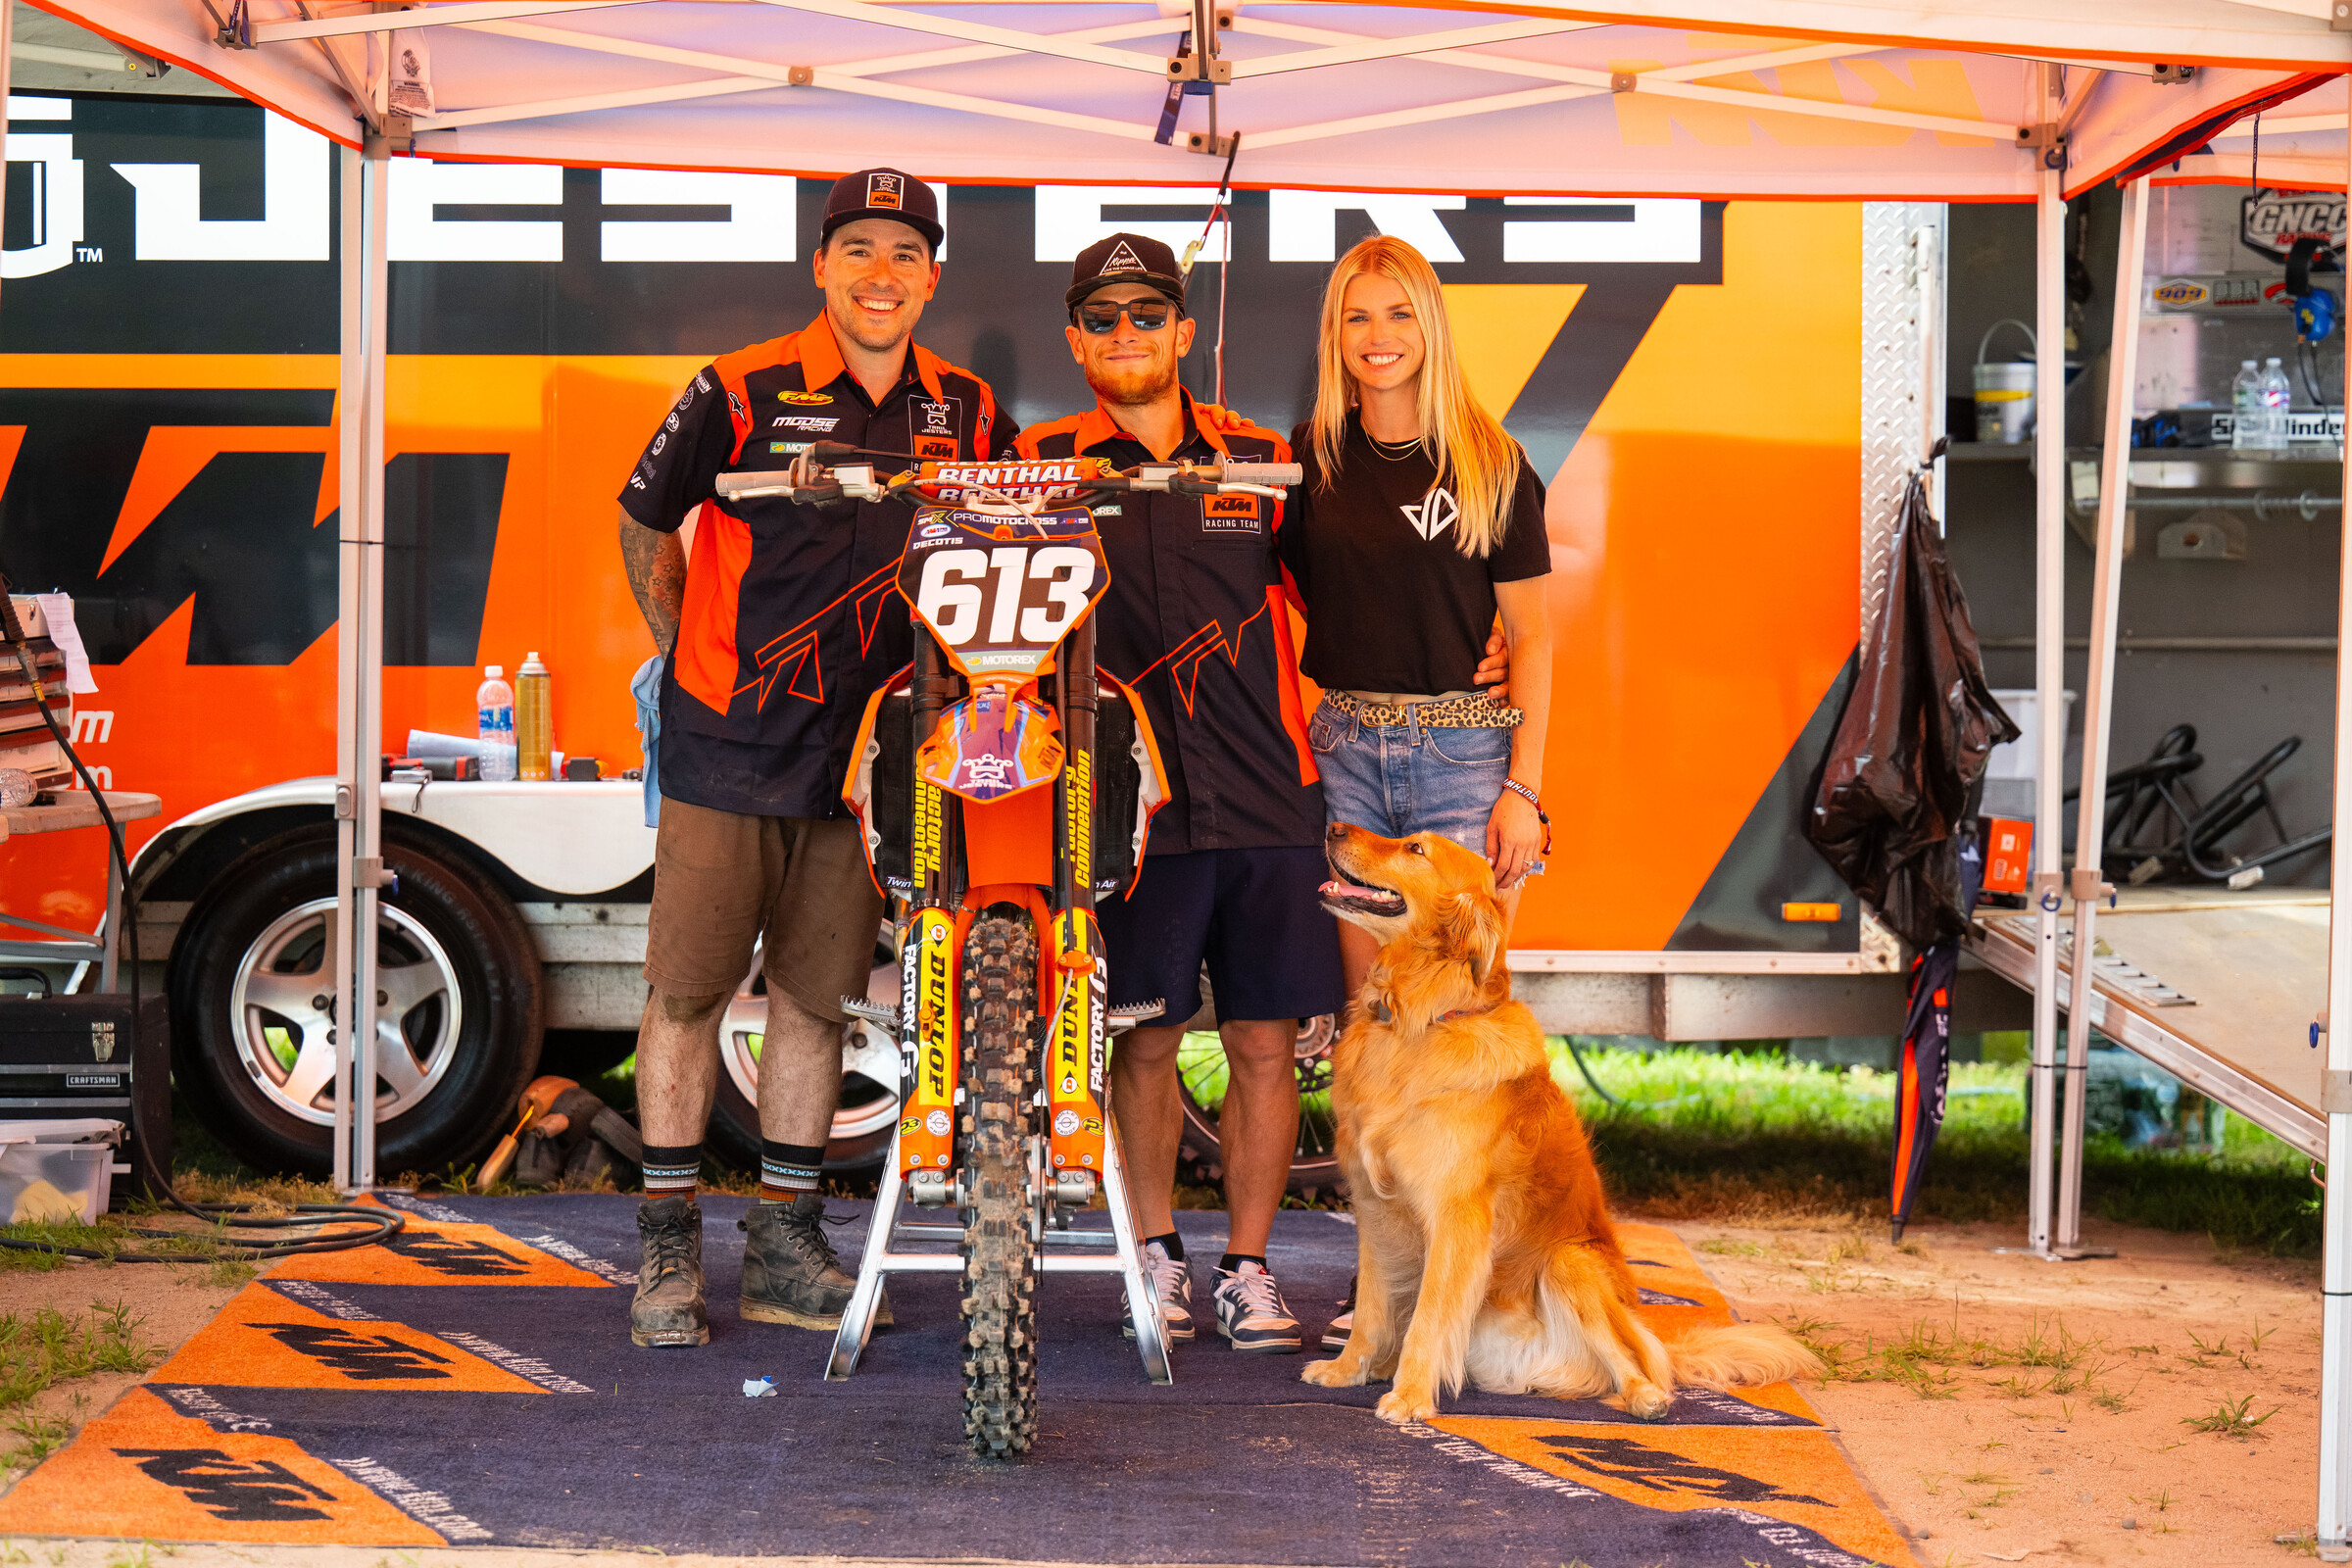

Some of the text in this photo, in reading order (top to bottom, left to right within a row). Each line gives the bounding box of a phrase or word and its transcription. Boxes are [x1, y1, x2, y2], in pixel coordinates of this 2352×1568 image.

[874, 195, 897, 204] KTM
[77, 248, 103, 262] TM
[779, 391, 833, 402] FMF
[772, 416, 840, 427] MOOSE
[921, 442, 954, 458] KTM
[938, 465, 1081, 485] RENTHAL
[1212, 497, 1252, 513] KTM
[1205, 519, 1259, 529] RACING TEAM
[913, 537, 963, 550] DECOTIS
[916, 547, 1096, 645] 613
[982, 655, 1036, 665] MOTOREX
[914, 766, 927, 889] nnection
[926, 784, 943, 872] actory
[887, 876, 911, 888] Twin
[903, 944, 917, 1033] FACTORY
[929, 951, 945, 1098] DUNLOP
[1090, 996, 1103, 1093] FACTORY
[70, 1076, 117, 1085] CRAFTSMAN
[243, 1322, 455, 1379] KTM
[111, 1447, 338, 1521] KTM
